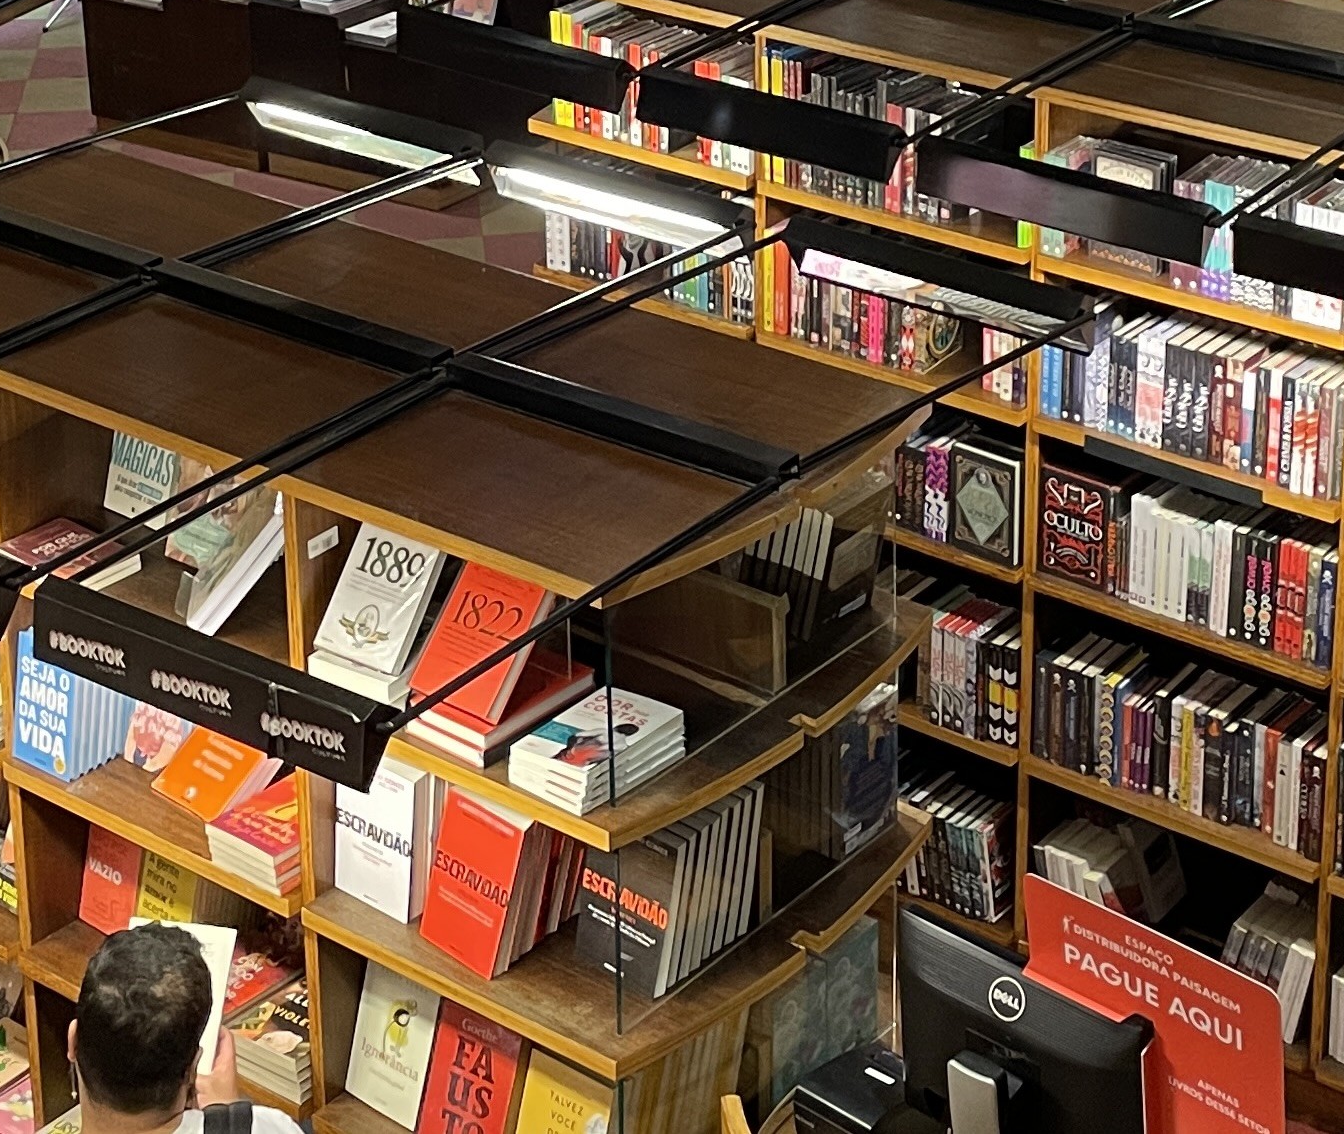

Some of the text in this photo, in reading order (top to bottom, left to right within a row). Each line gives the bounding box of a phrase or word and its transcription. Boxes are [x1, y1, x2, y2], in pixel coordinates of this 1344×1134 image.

[1044, 510, 1103, 541] OCULTO
[356, 536, 426, 588] 1889
[450, 590, 523, 642] 1822
[49, 630, 127, 669] #BOOKTOK
[22, 655, 70, 691] SEJA O
[150, 669, 232, 710] #BOOKTOK
[20, 678, 69, 718] AMOR
[19, 702, 67, 737] DA SUA
[261, 711, 347, 754] #BOOKTOK
[18, 726, 65, 761] VIDA
[337, 807, 414, 858] ESCRAVIDÃO
[88, 857, 123, 886] VAZIO
[436, 849, 510, 908] ESCRAVIDÃO
[582, 867, 669, 930] ESCRAVIDÃO
[1073, 923, 1242, 1014] DISTRIBUIDORA PAISAGEM
[1125, 934, 1174, 965] ESPAÇO
[992, 989, 1021, 1011] DELL
[1064, 945, 1244, 1050] PAGUE AQUI
[461, 1018, 498, 1041] Goethe
[362, 1037, 420, 1082] Ignorância
[452, 1035, 495, 1084] FA
[447, 1071, 493, 1120] US
[550, 1089, 584, 1117] TALVEZ
[1168, 1076, 1271, 1134] LIVROS DESSE SETOR
[1197, 1079, 1240, 1109] APENAS
[550, 1109, 577, 1132] VOCÊ
